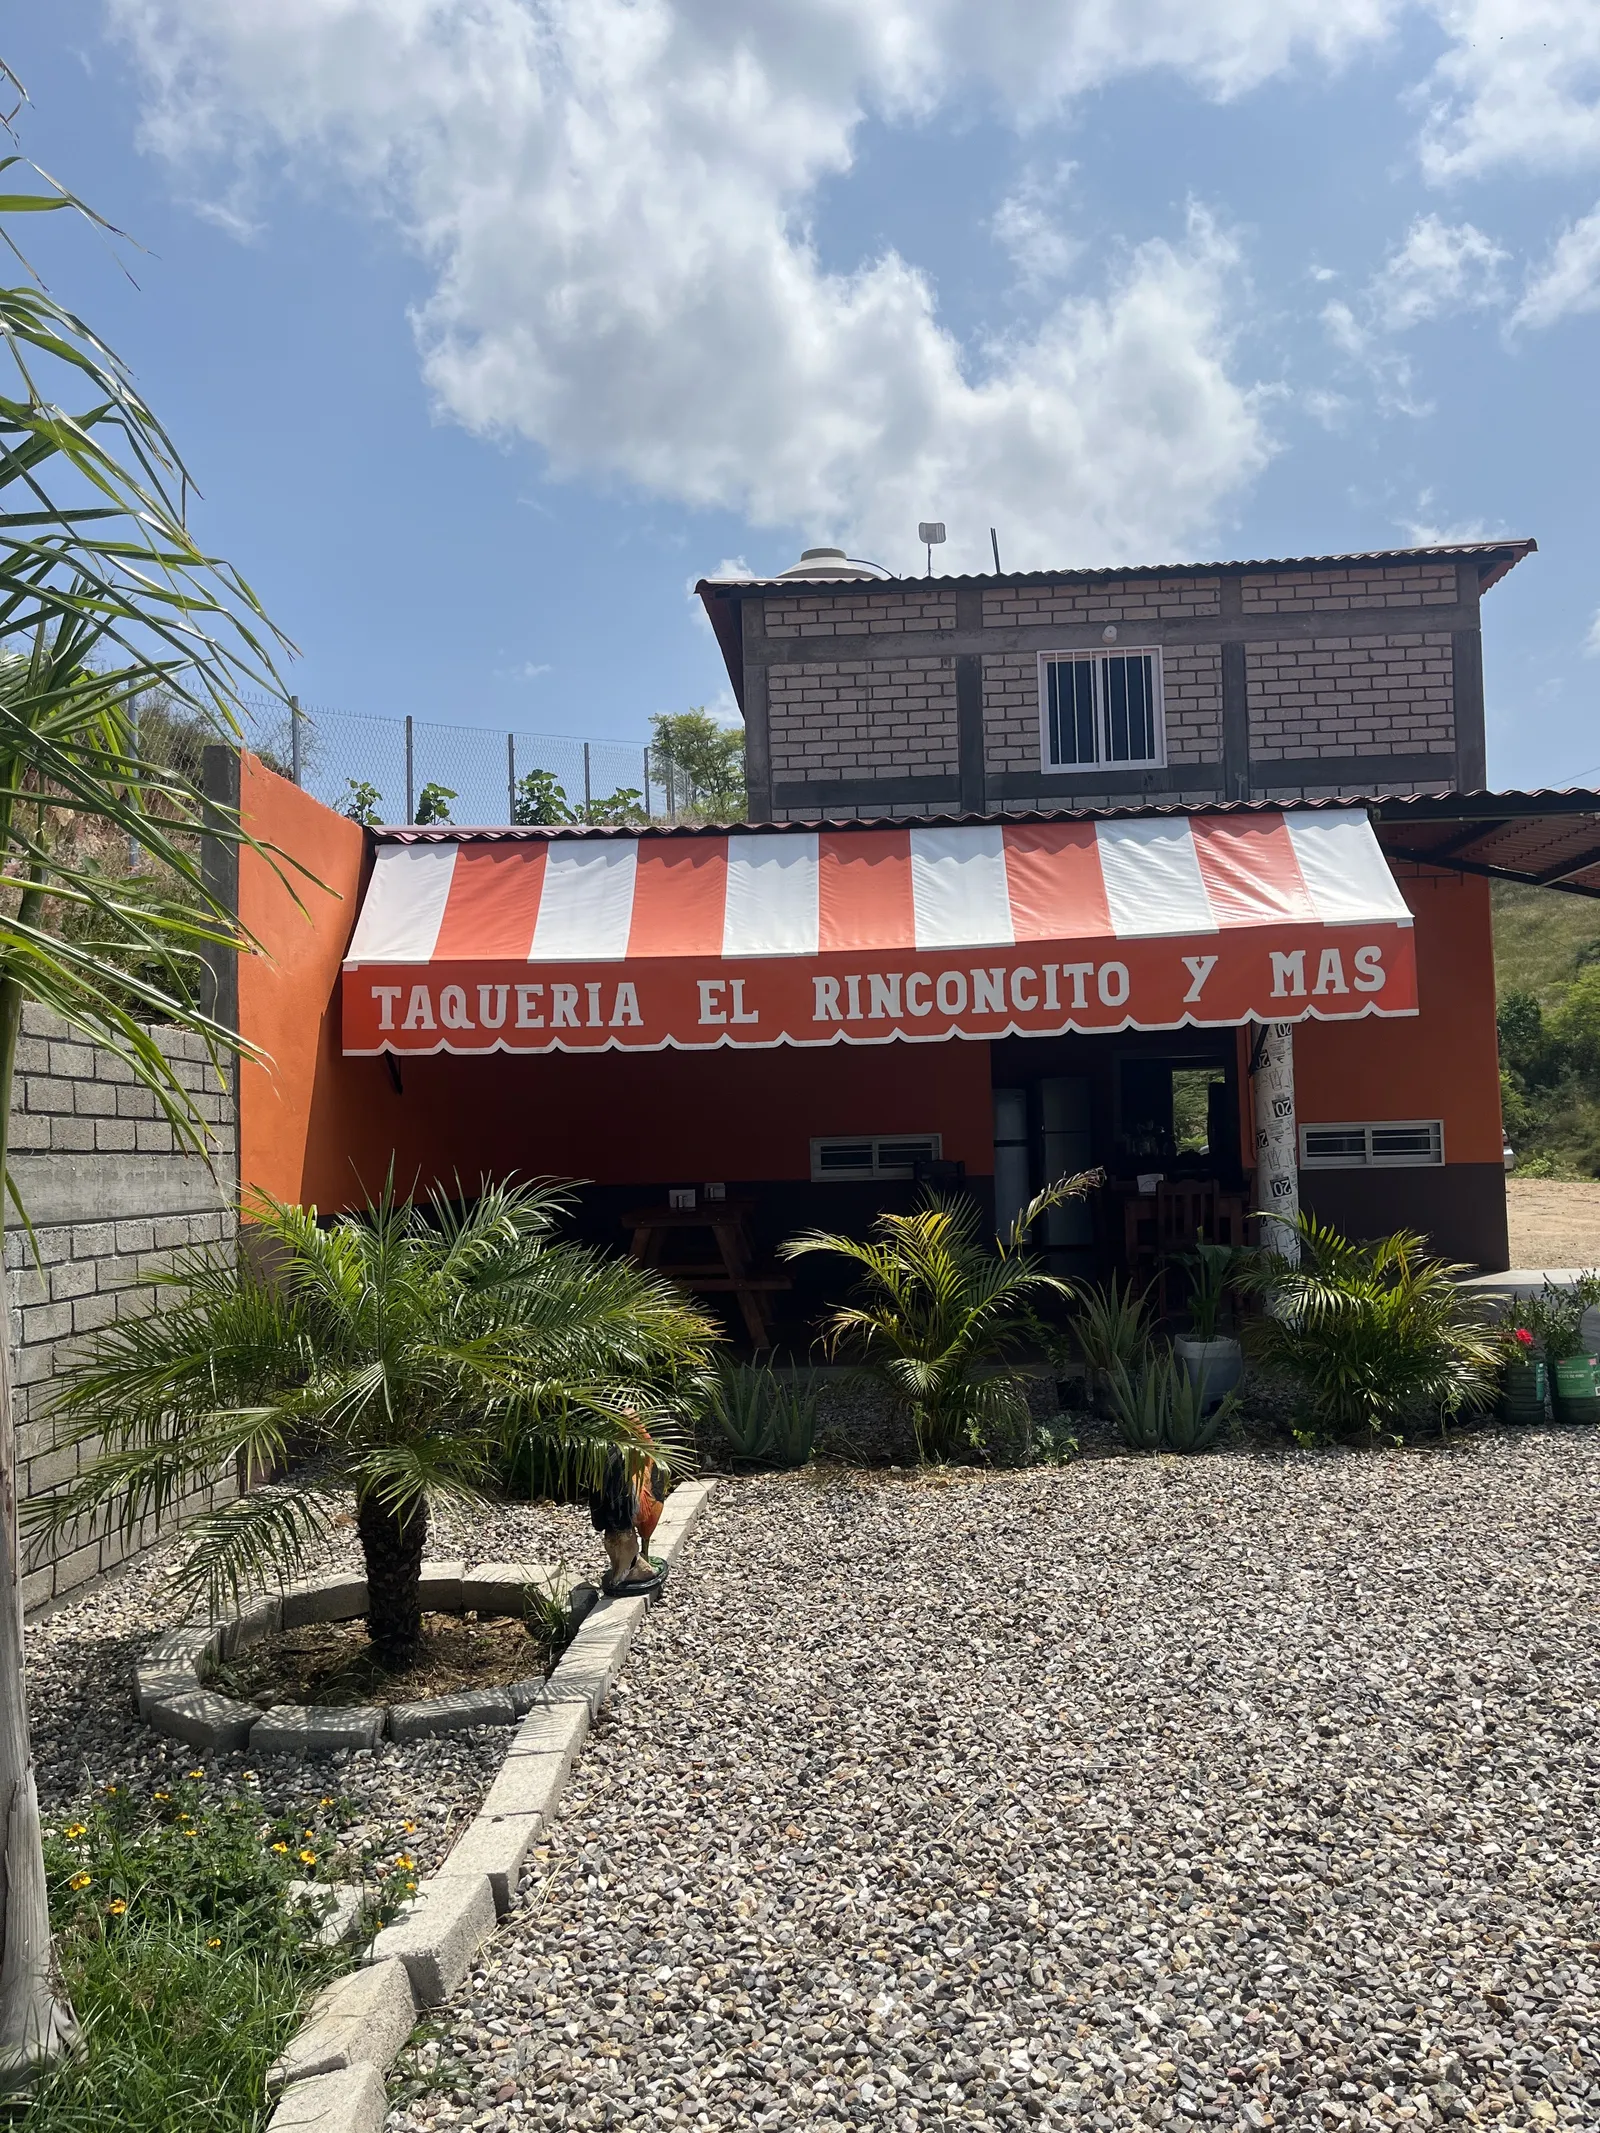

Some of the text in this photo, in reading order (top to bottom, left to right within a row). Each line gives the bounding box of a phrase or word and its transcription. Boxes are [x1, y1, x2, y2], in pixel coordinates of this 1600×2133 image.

[371, 945, 1386, 1030] TAQUERIA EL RINCONCITO Y MAS
[1275, 1100, 1292, 1117] 20
[1273, 1180, 1291, 1197] 20
